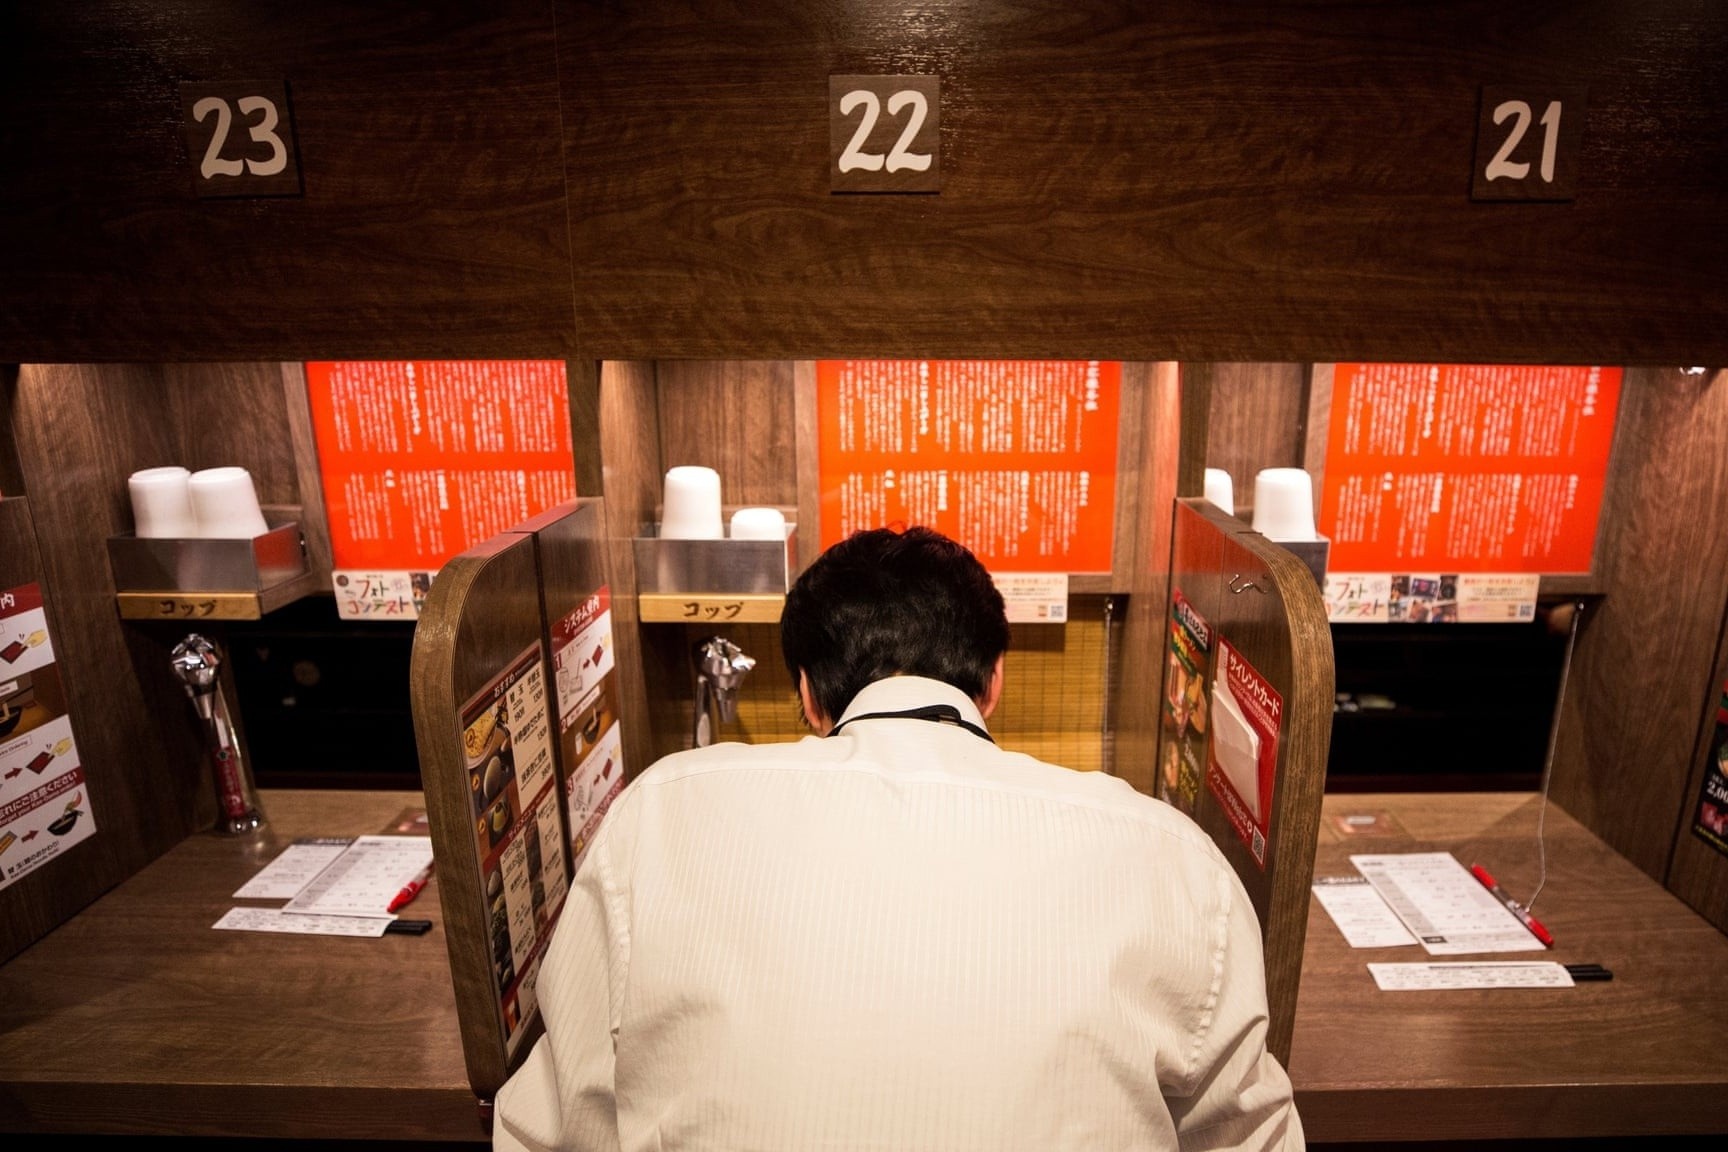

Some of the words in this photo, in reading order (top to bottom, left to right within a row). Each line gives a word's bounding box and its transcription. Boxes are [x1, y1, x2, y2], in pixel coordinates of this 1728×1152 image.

[192, 95, 288, 179] 23
[839, 90, 932, 173] 22
[1485, 100, 1562, 183] 21
[355, 578, 390, 599] フォト
[1334, 580, 1368, 600] フォト
[159, 599, 217, 617] コップ
[346, 596, 410, 615] コンテスト
[683, 601, 745, 620] コップ
[1229, 654, 1280, 716] サイレントカード
